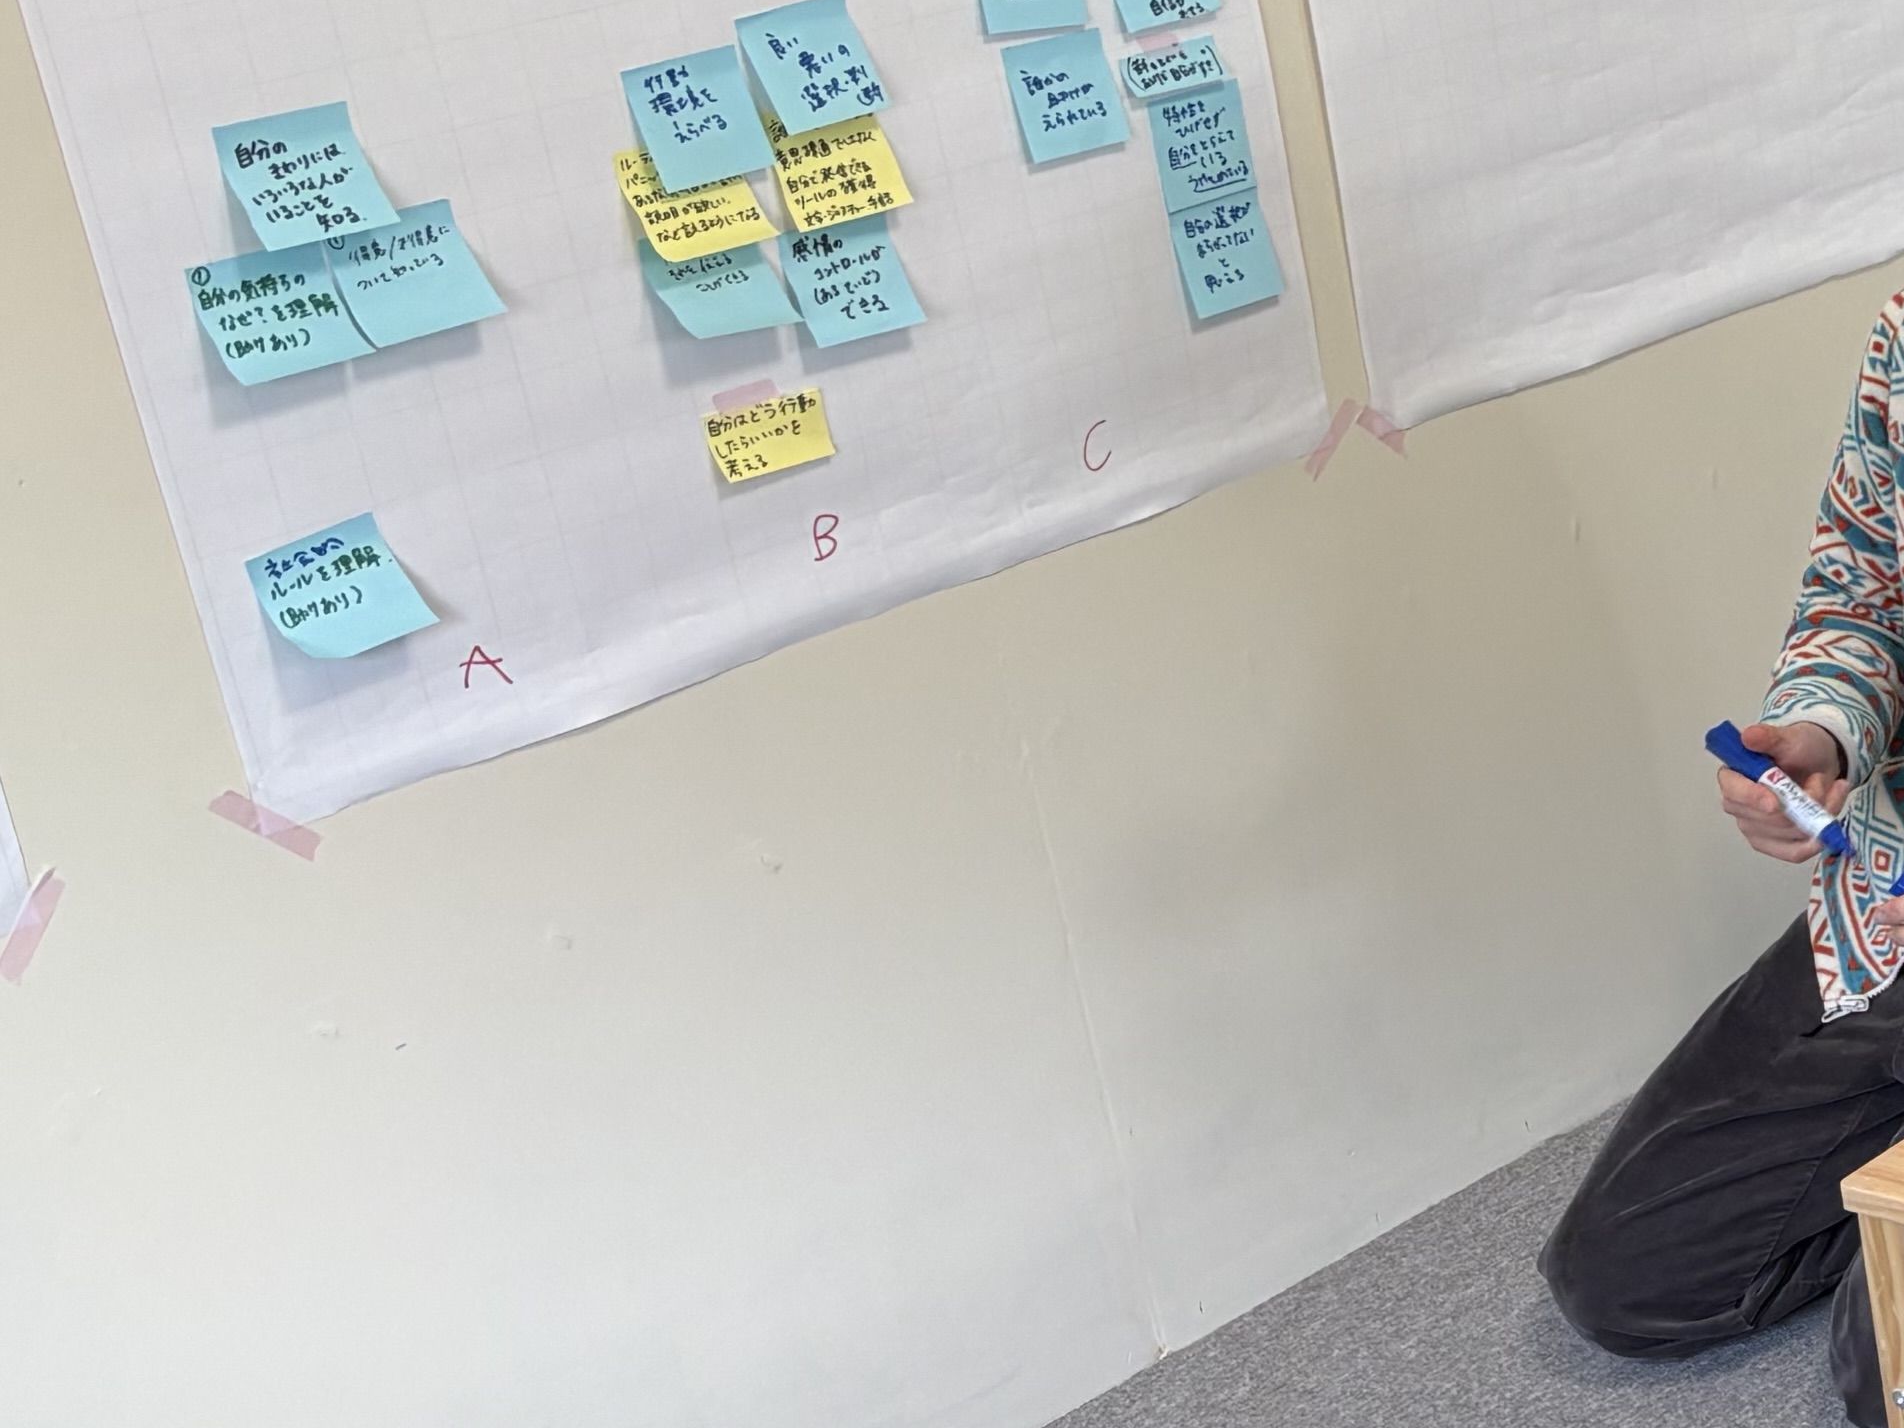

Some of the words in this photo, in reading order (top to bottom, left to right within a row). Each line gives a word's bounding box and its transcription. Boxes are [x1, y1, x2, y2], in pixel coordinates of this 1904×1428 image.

[234, 139, 288, 168] 自分の
[252, 167, 353, 205] いろいろな人が
[266, 195, 334, 223] いることを
[198, 273, 306, 311] 自分の気持ちの
[840, 297, 889, 319] できる
[707, 393, 817, 438] 自分はどう行動
[1083, 419, 1112, 471] C
[726, 454, 769, 478] 考える
[813, 514, 839, 561] B
[459, 645, 513, 688] A
